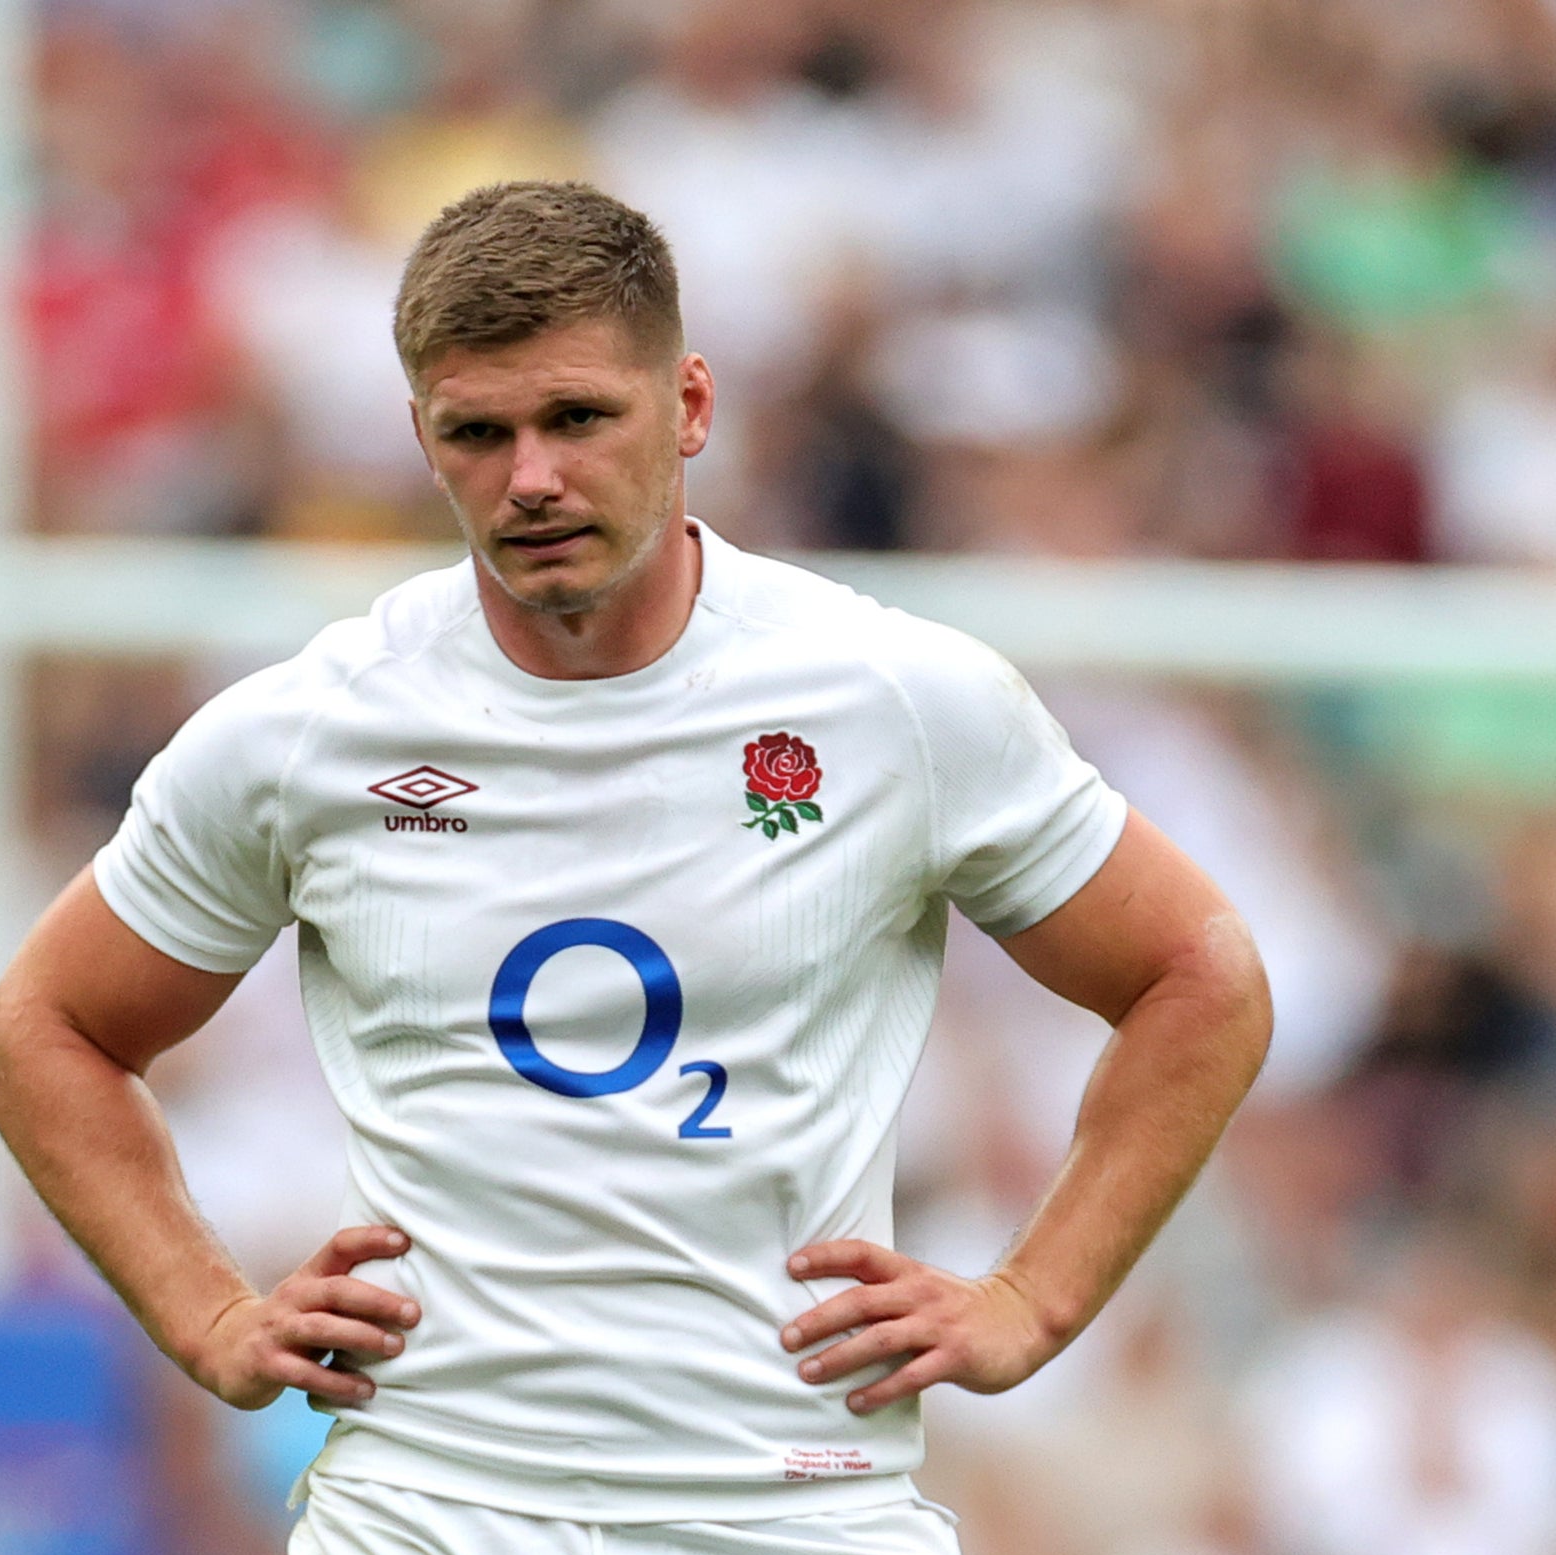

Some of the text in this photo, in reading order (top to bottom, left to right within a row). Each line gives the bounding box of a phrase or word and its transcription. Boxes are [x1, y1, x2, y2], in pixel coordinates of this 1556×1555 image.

[385, 811, 468, 832] umbro
[784, 1457, 831, 1469] England
[842, 1460, 872, 1471] Wales
